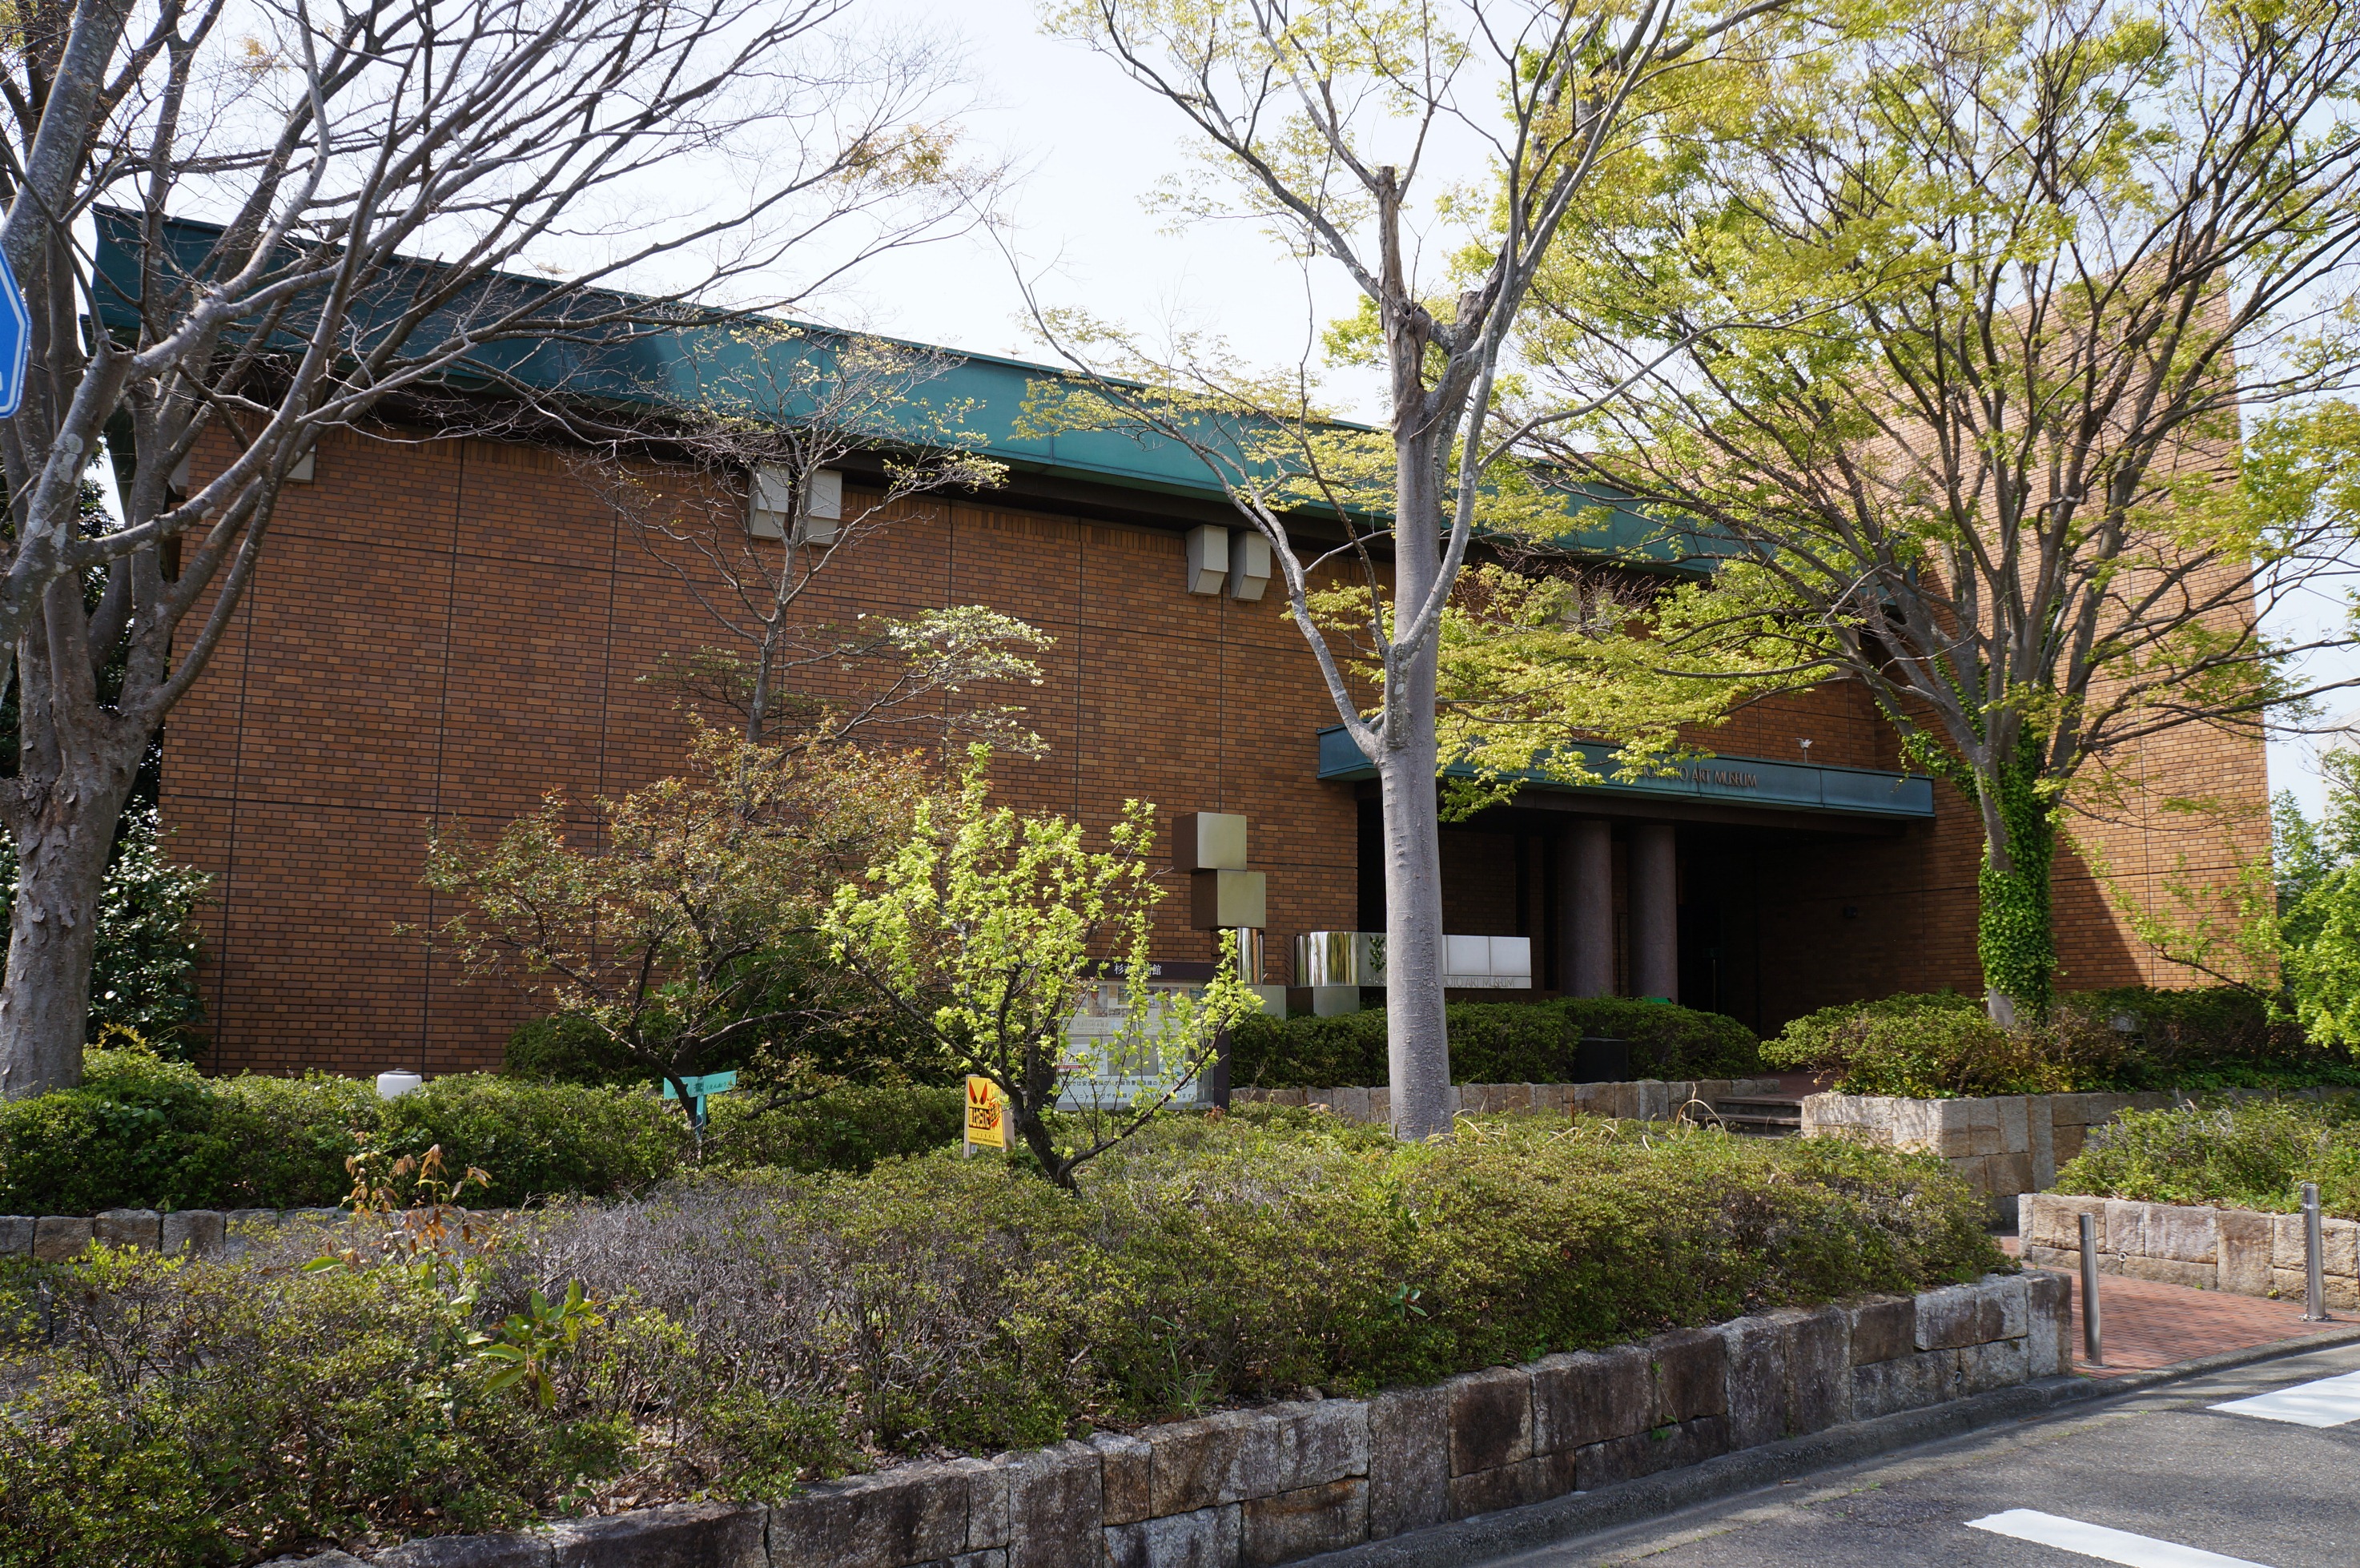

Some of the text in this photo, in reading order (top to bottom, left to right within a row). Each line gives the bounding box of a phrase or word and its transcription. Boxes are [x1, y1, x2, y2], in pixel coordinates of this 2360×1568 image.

[1691, 768, 1711, 783] ART
[1715, 770, 1758, 788] MUSEUM
[1465, 977, 1479, 987] ART
[1483, 977, 1515, 988] MUSEUM
